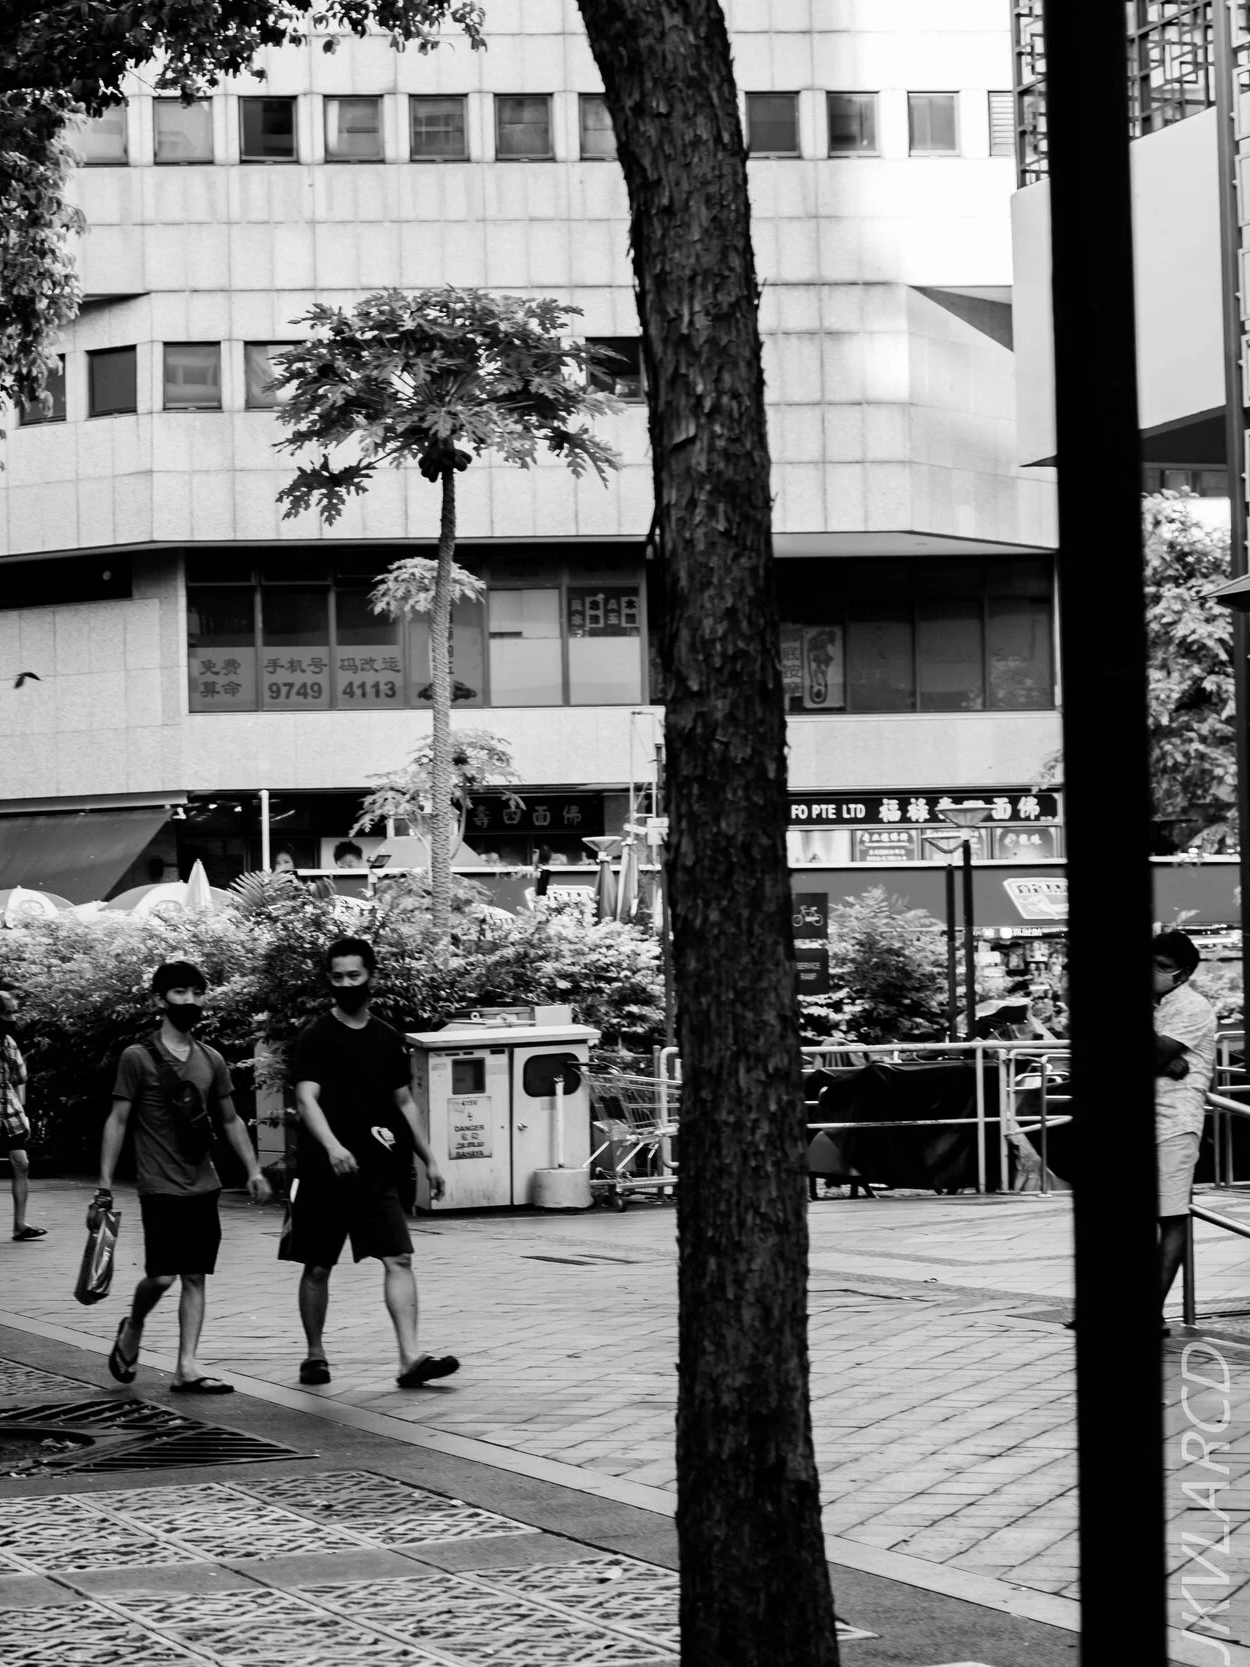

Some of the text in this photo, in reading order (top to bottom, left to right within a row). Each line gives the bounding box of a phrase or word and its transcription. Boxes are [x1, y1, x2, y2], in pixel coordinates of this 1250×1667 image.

[199, 656, 401, 676] 免费 手机号 码改运
[200, 680, 242, 698] 算命
[268, 680, 397, 699] 9749 4113
[791, 804, 866, 819] FO PTE LTD
